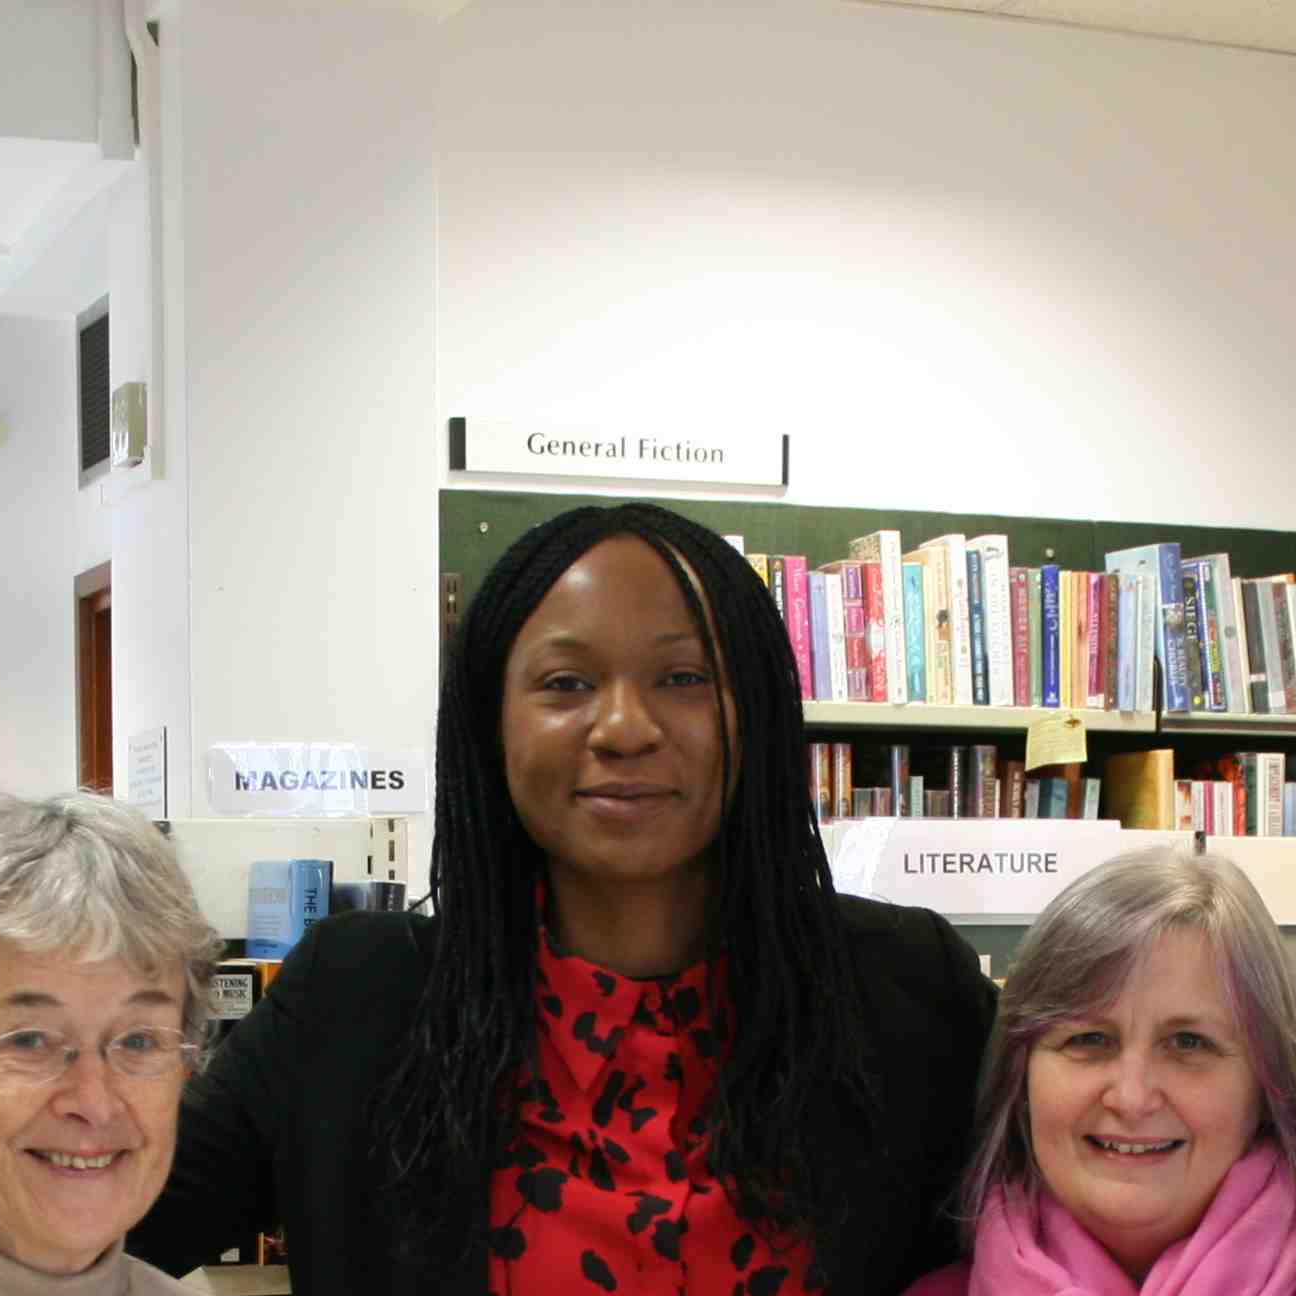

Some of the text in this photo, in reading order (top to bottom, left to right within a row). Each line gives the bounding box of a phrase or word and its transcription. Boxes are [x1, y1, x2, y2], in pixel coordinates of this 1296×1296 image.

[526, 432, 724, 465] General Fiction
[235, 770, 405, 791] MAGAZINES
[903, 852, 1059, 875] LITERATURE
[304, 887, 317, 914] THE
